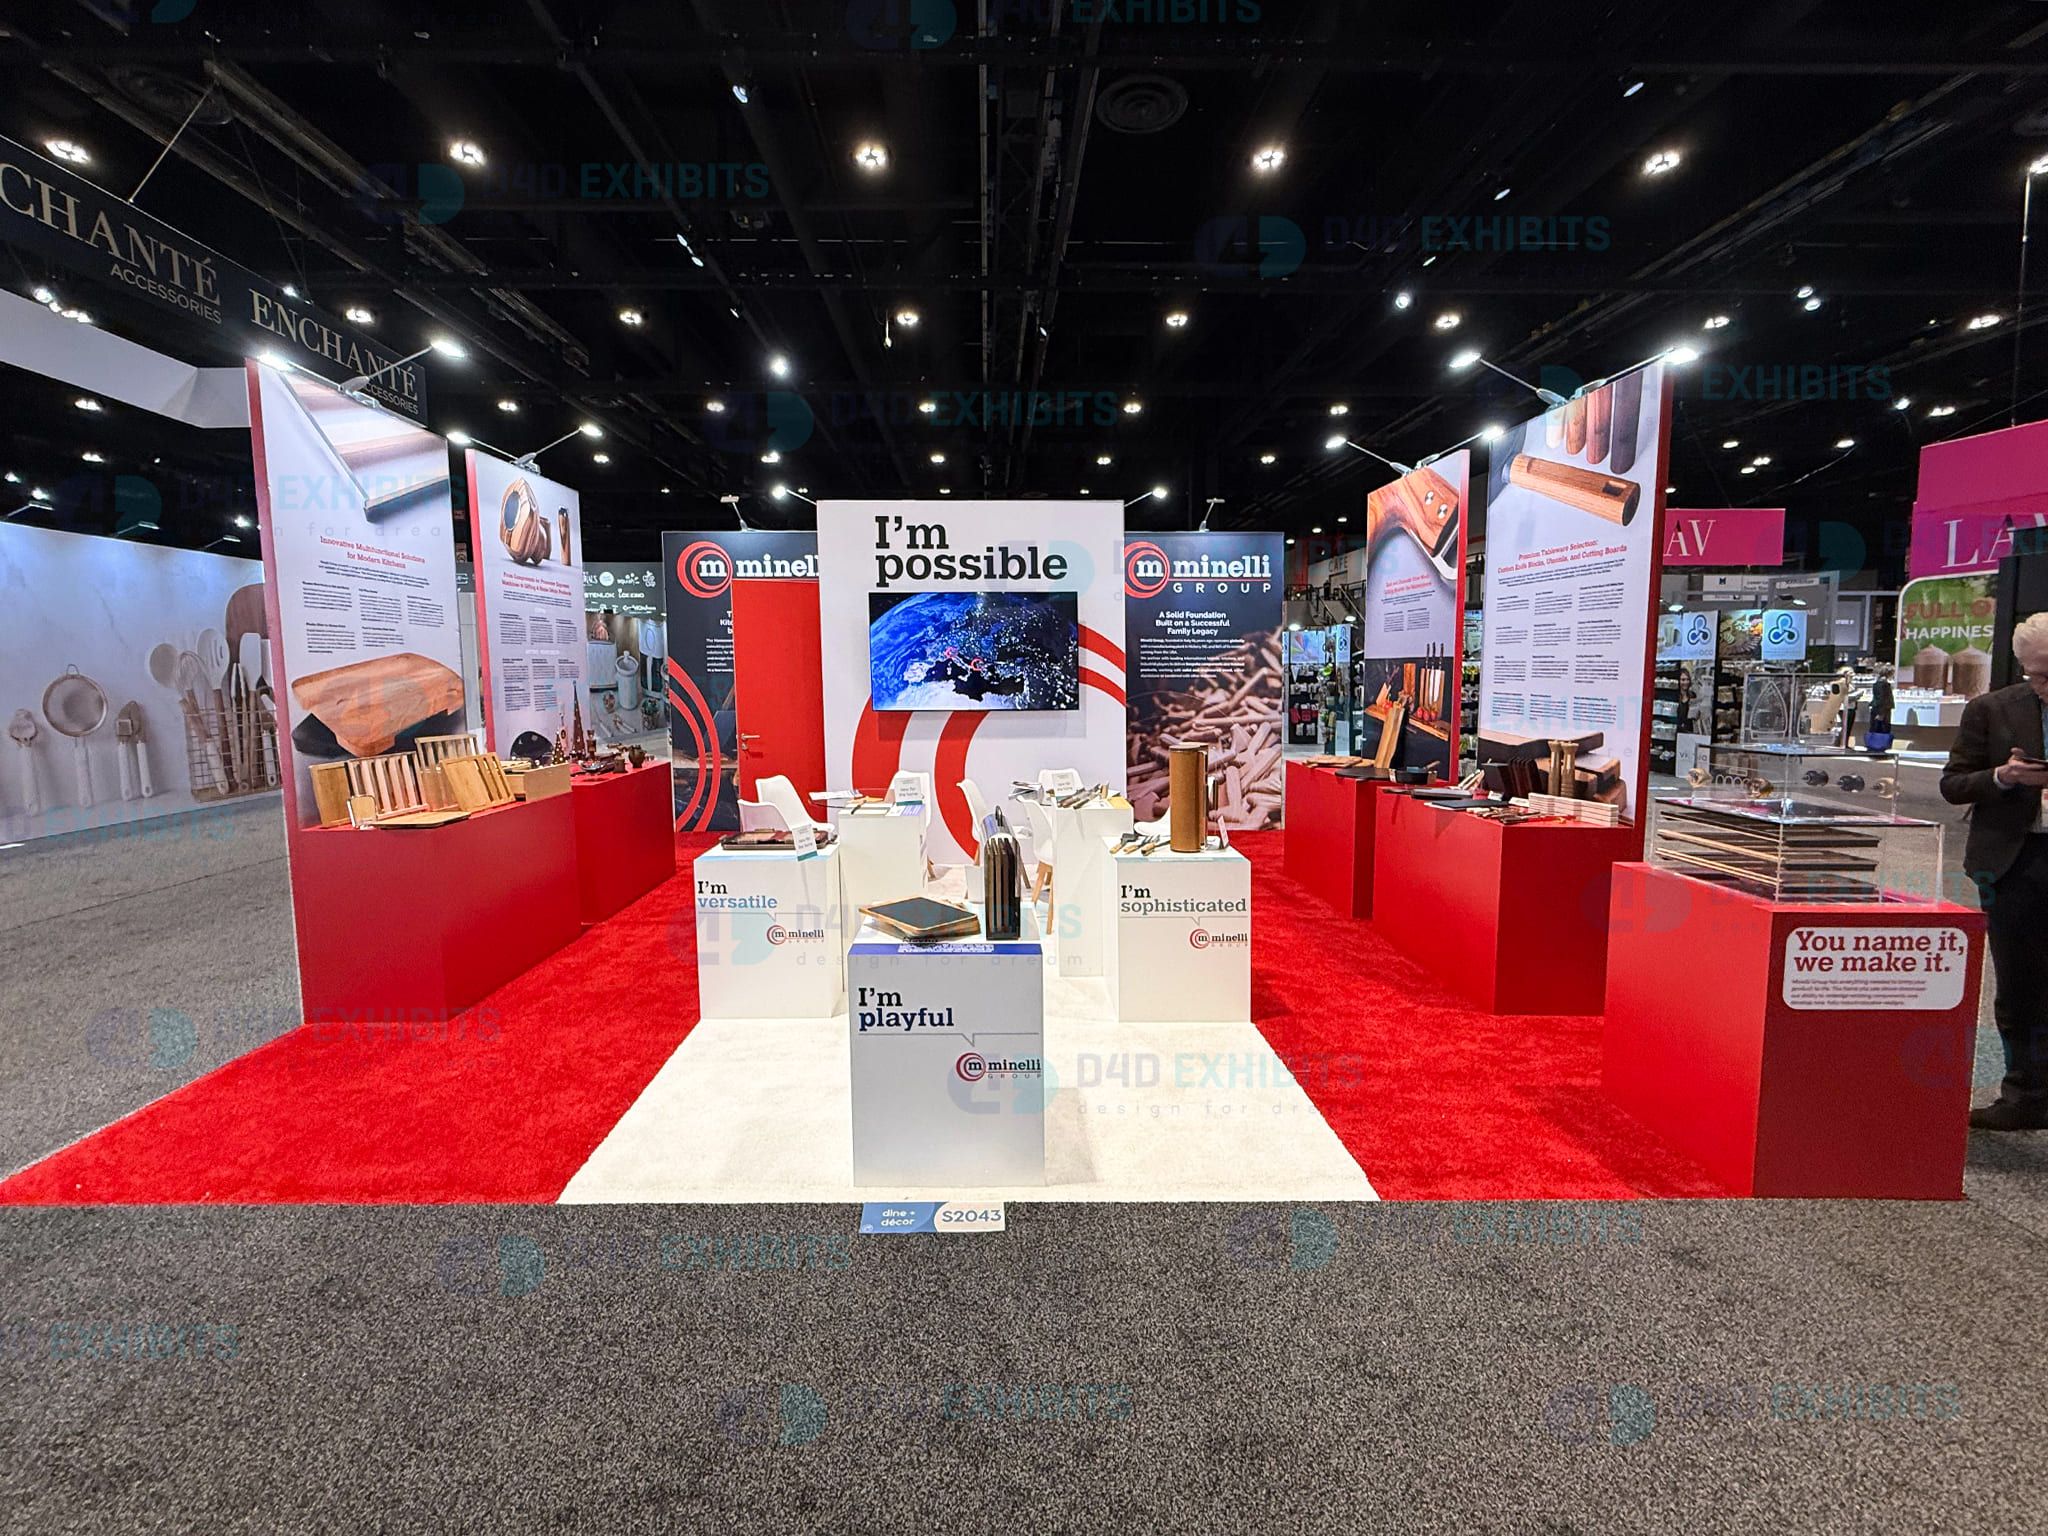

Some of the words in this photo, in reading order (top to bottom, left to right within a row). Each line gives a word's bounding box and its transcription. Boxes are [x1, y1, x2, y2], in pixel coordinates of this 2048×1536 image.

[0, 163, 220, 305] CHANTÉ
[110, 263, 222, 324] ACCESSORIES
[249, 288, 418, 401] ENCHANTÉ
[365, 383, 419, 415] CCESSORIES
[875, 515, 949, 549] I'm
[320, 536, 354, 549] Innovative
[357, 553, 381, 563] Modern
[1570, 552, 1580, 560] and
[1581, 549, 1604, 559] Cutting
[1605, 544, 1627, 555] Boards
[736, 554, 819, 577] minel
[875, 546, 1068, 588] possible
[1173, 554, 1271, 577] minelli
[1173, 582, 1271, 593] GROUP
[1906, 601, 1966, 619] FULL
[1970, 599, 1992, 618] O
[1167, 628, 1190, 636] Family
[1191, 628, 1218, 636] Legacy
[1905, 625, 1994, 640] HAPPINES
[698, 881, 728, 894] I'm
[1121, 885, 1151, 898] I'm
[698, 895, 777, 908] versatile
[1121, 898, 1247, 915] sophisticated
[788, 929, 824, 938] minelli
[1211, 933, 1248, 941] minelli
[1796, 931, 1845, 951] You
[1852, 935, 1931, 951] name
[1939, 931, 1964, 955] it,
[1794, 956, 1833, 972] we
[1841, 952, 1917, 972] make
[1924, 952, 1950, 972] it.
[858, 987, 903, 1006] I'm
[858, 1008, 954, 1031] playful
[988, 1059, 1041, 1070] minelli
[882, 1209, 907, 1217] dine
[942, 1209, 1002, 1222] S2043
[881, 1218, 915, 1226] décor
